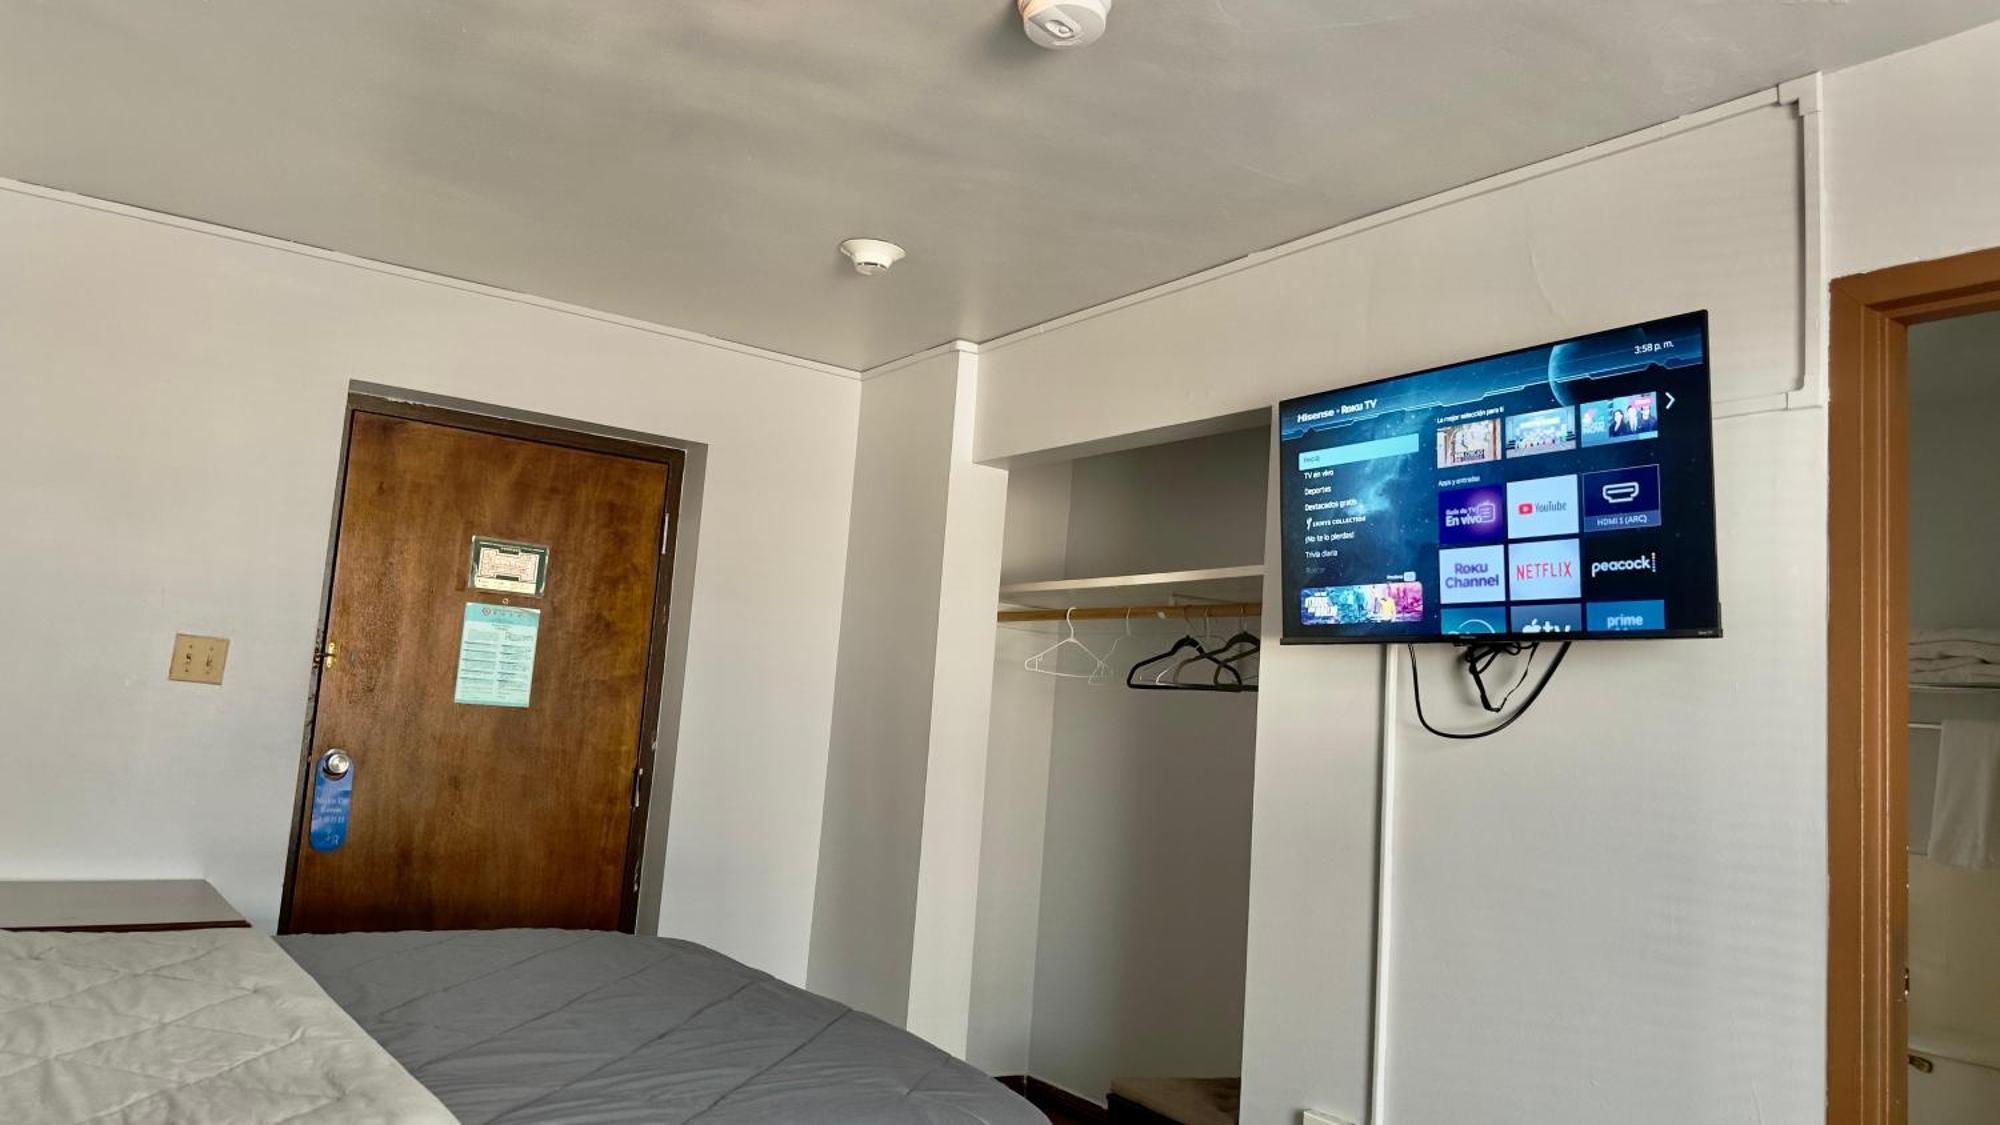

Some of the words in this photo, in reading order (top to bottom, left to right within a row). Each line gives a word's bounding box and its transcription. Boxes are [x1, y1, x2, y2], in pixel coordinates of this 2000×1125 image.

[1634, 343, 1653, 354] 3:58
[1297, 409, 1334, 423] Hisense
[1341, 402, 1363, 414] Roku
[1363, 398, 1378, 409] TV
[1304, 471, 1312, 479] TV
[1322, 469, 1334, 477] vivo
[1304, 486, 1332, 496] Deportes
[1304, 501, 1339, 511] Destacados
[1535, 501, 1567, 513] YouTube
[1332, 516, 1366, 525] COLLECTION
[1446, 515, 1460, 527] En
[1460, 513, 1482, 525] vivo
[1597, 518, 1619, 526] HDMI
[1625, 514, 1648, 525] (ARC)
[1305, 550, 1320, 559] Trivia
[1321, 549, 1338, 558] diaria
[1516, 561, 1572, 580] NETFLIX
[1591, 555, 1651, 578] peacock
[1445, 574, 1500, 588] Channel
[1607, 614, 1643, 630] prime
